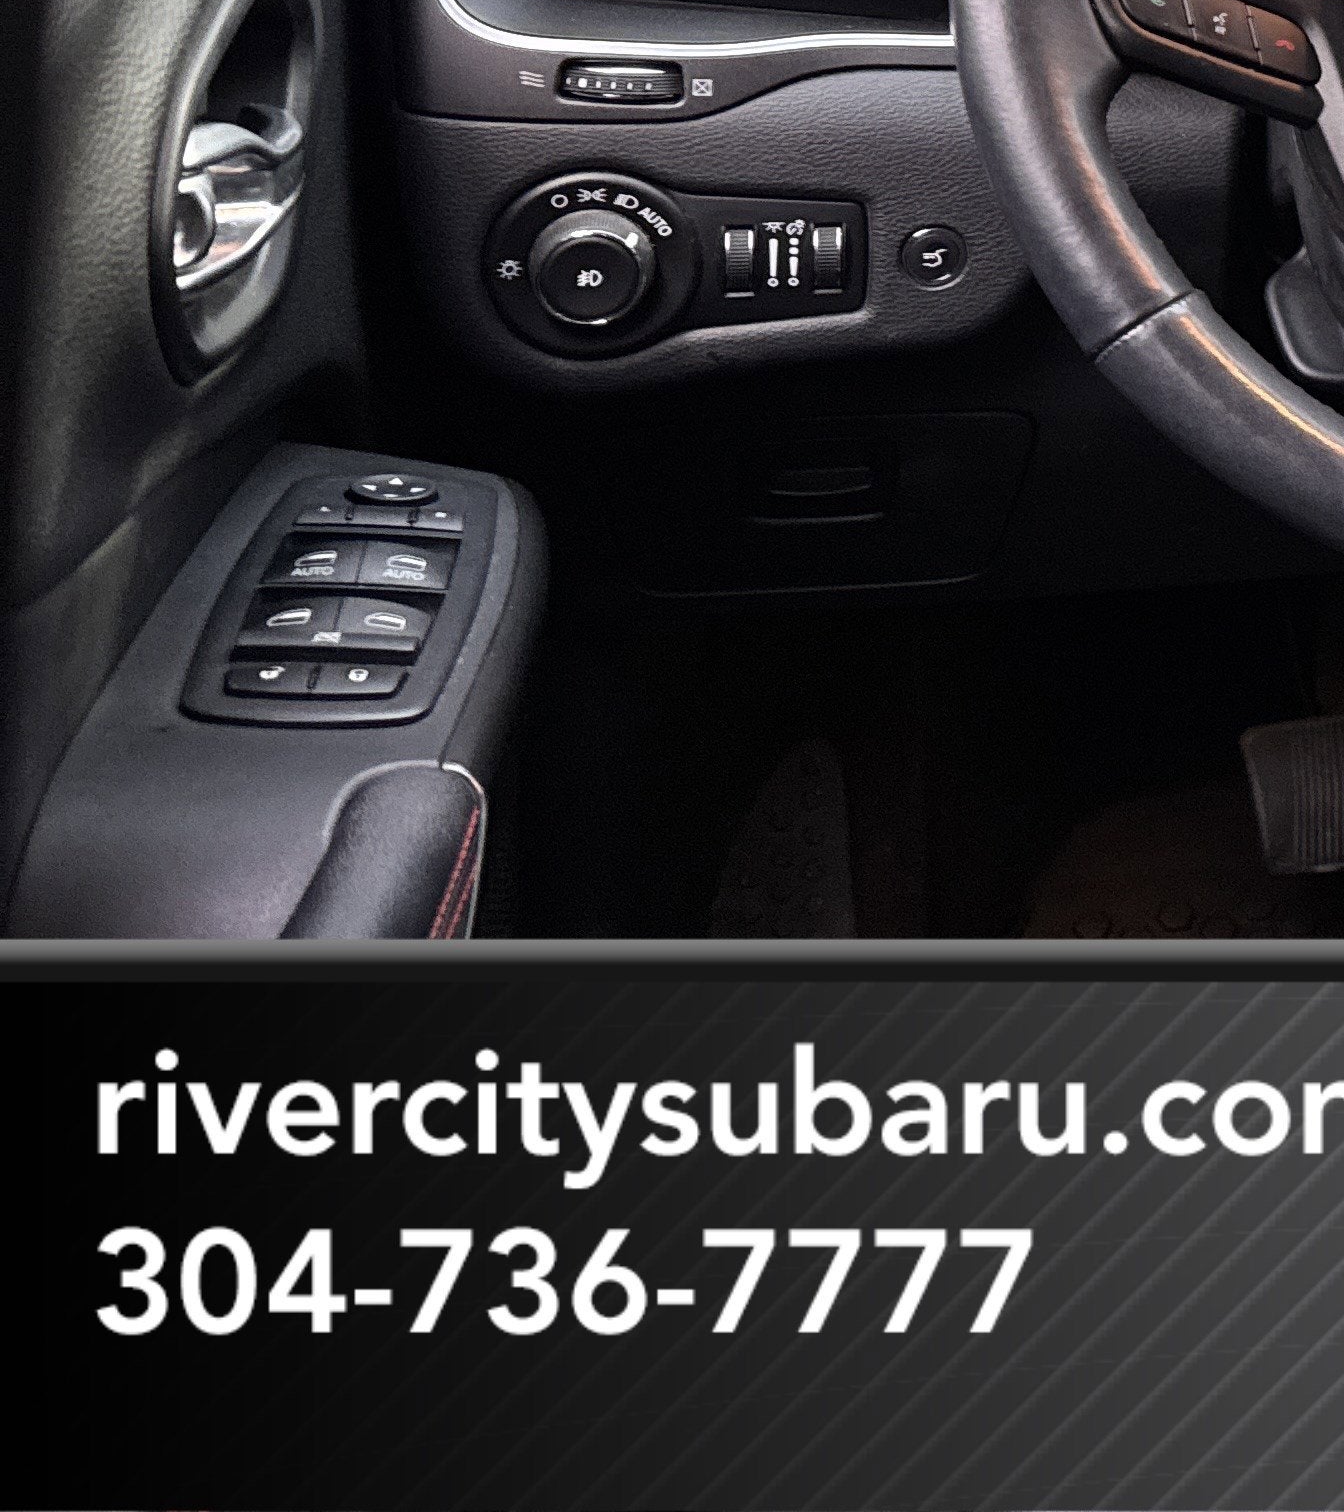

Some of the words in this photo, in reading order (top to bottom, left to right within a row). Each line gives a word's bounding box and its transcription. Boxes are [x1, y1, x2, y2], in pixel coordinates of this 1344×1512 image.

[637, 207, 673, 236] AUTO
[290, 565, 335, 577] AUTO
[382, 568, 425, 581] AUTO
